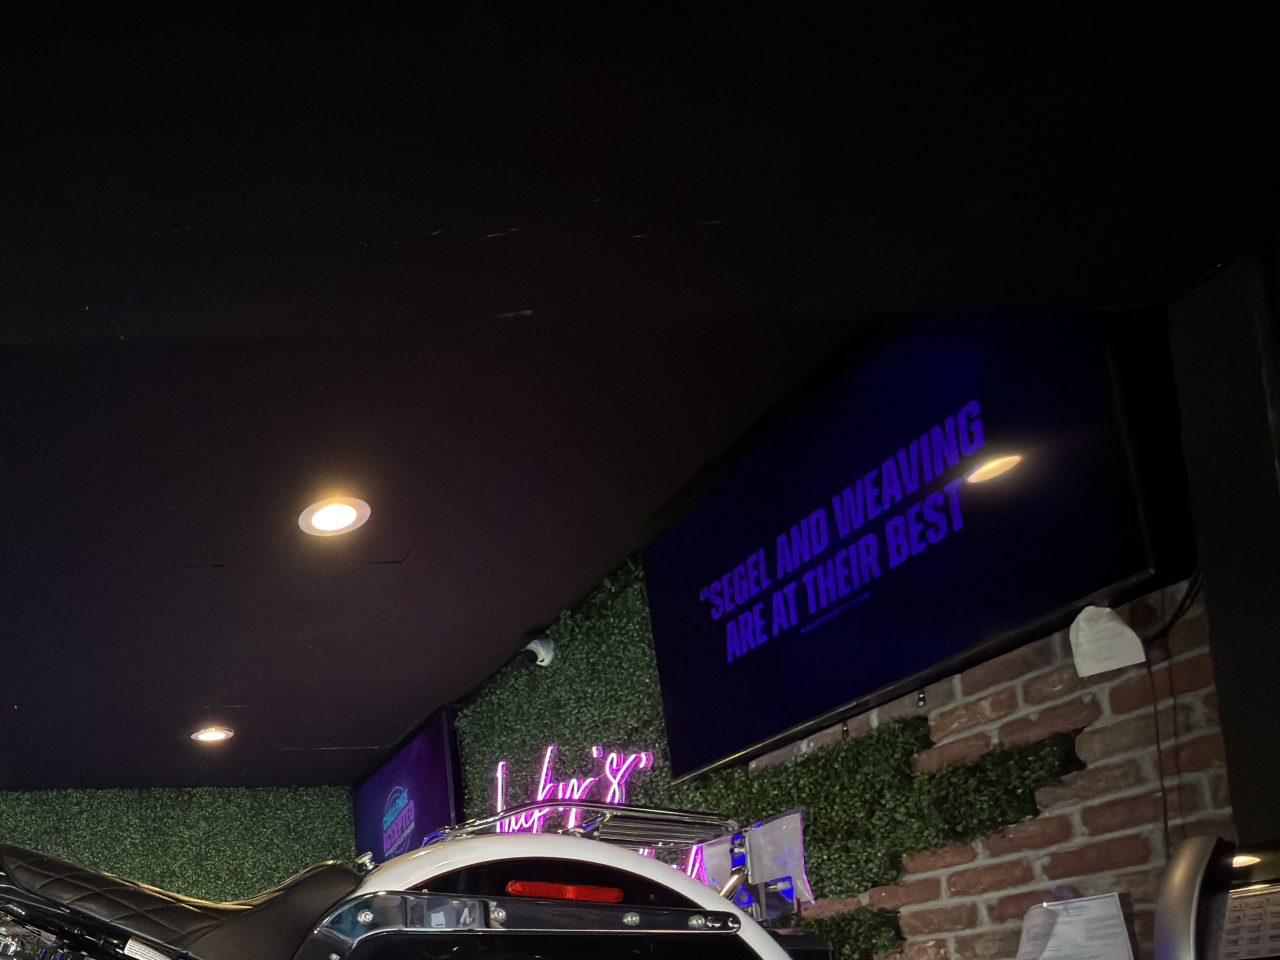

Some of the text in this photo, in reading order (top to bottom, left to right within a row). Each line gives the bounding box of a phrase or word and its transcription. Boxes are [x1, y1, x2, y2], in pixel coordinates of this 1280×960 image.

[726, 478, 965, 665] ARE AT THEIR BEST
[776, 507, 829, 582] AND
[831, 399, 986, 540] WEAVING
